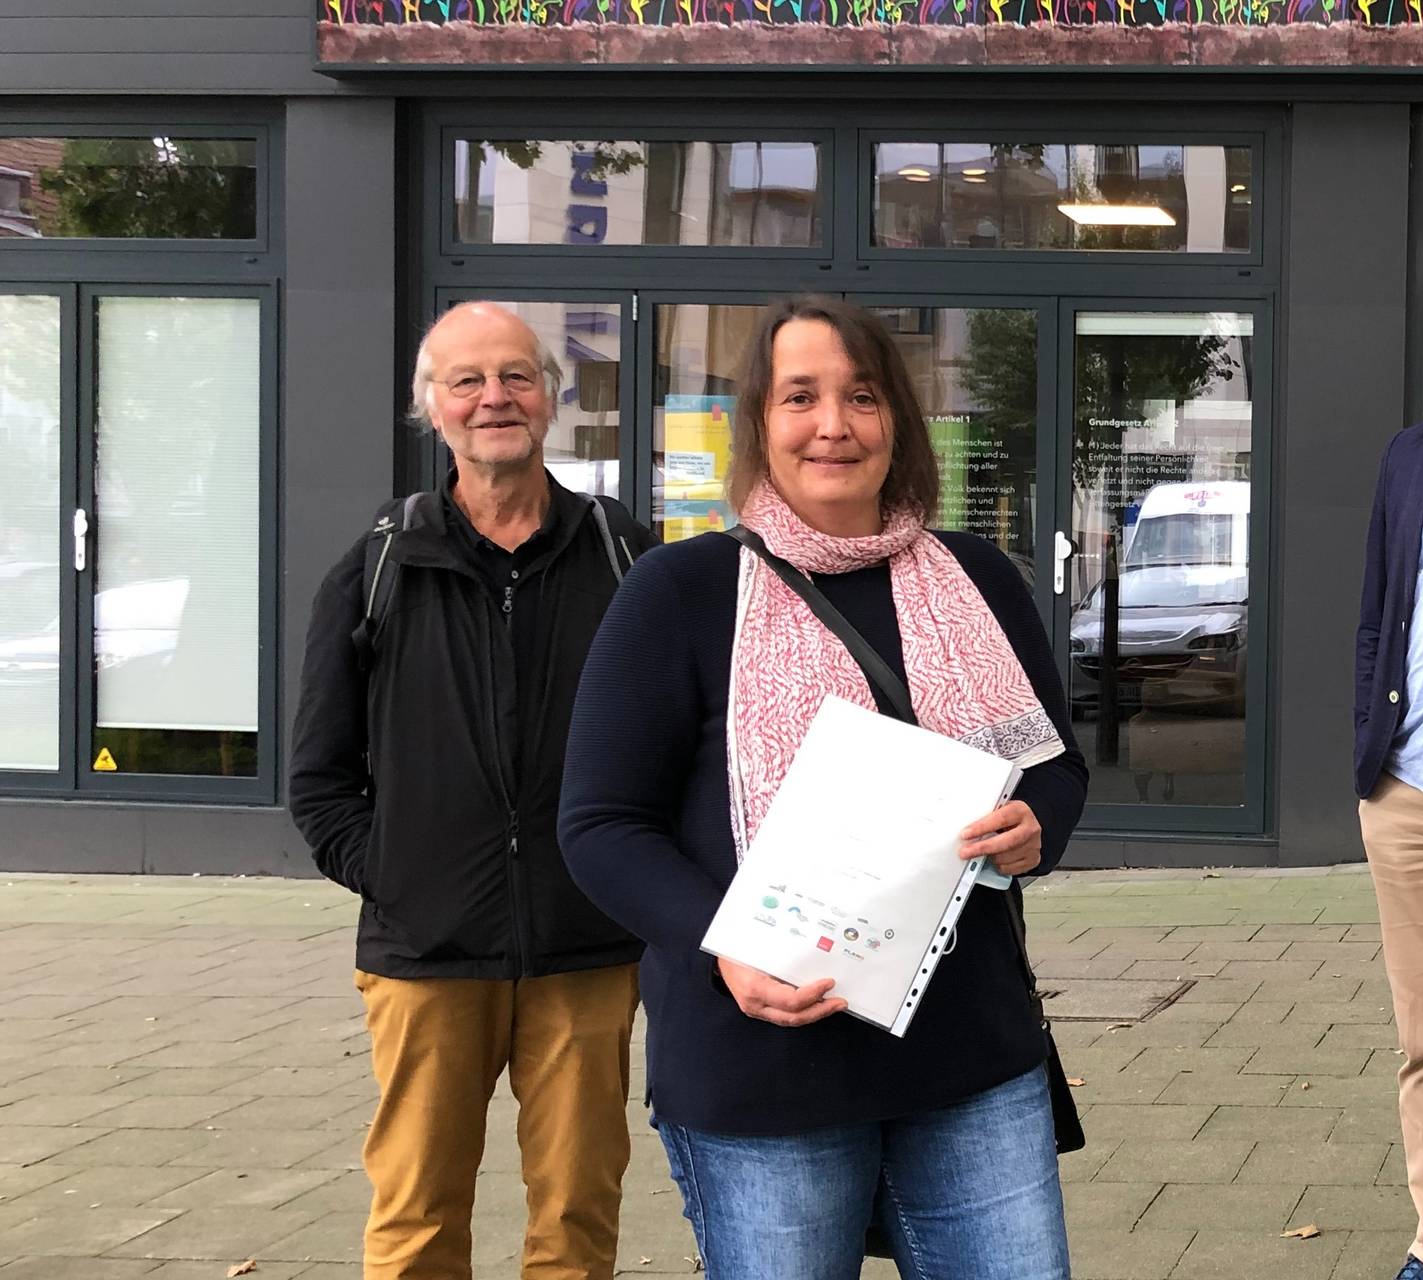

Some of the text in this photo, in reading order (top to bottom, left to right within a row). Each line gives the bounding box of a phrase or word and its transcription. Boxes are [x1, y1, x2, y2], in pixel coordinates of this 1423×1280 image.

[935, 415, 963, 423] Artikel
[1088, 418, 1141, 428] Grundgesetz
[952, 439, 993, 447] Menschen
[955, 451, 981, 459] achten
[982, 451, 998, 459] und
[1088, 453, 1128, 463] Entfaltung
[1129, 454, 1153, 463] seiner
[980, 462, 998, 470] aller
[1125, 466, 1144, 474] nicht
[1145, 466, 1159, 474] die
[1160, 466, 1187, 475] Rechte
[1135, 478, 1155, 486] nicht
[966, 485, 998, 493] bekennt
[999, 486, 1016, 494] sich
[978, 497, 994, 505] und
[957, 519, 1011, 528] menschlichen
[988, 531, 1004, 540] und
[1005, 532, 1020, 540] der
